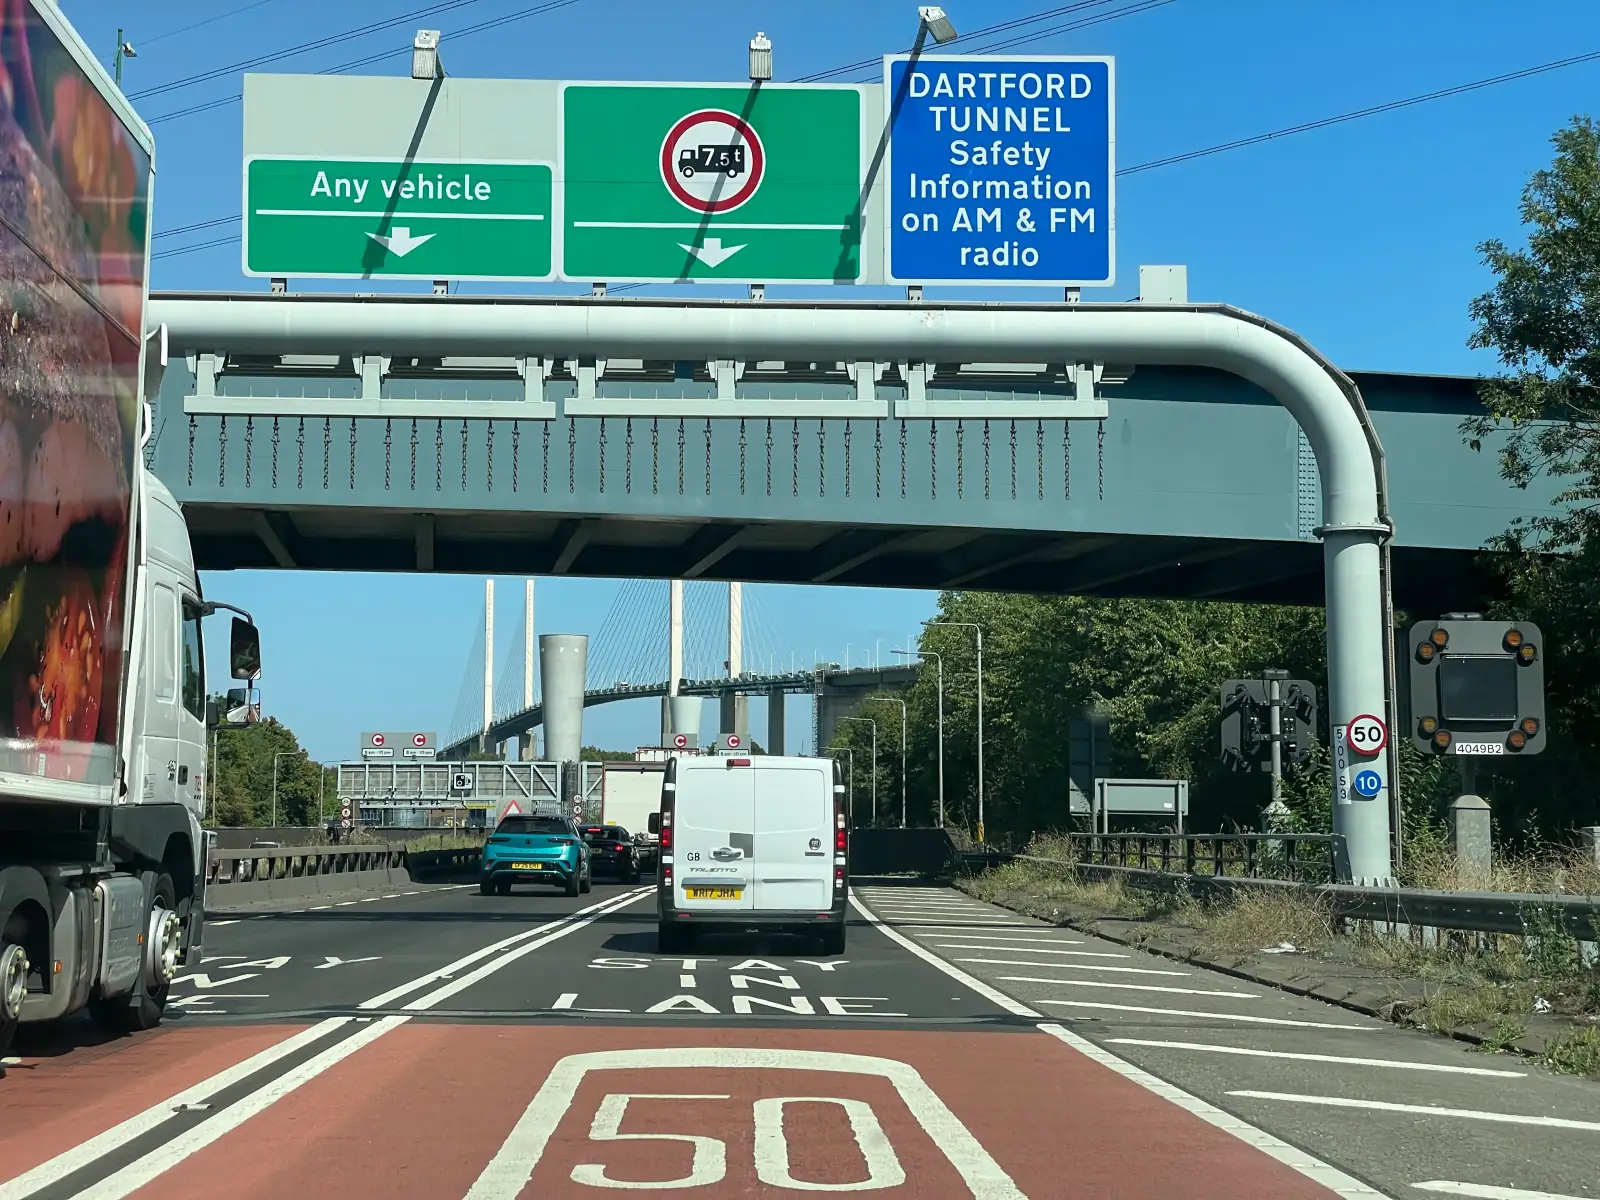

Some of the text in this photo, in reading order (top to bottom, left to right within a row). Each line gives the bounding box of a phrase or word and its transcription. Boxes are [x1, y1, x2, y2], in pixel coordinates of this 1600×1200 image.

[909, 72, 1092, 99] DARTFORD
[929, 106, 1071, 132] TUNNEL
[950, 139, 1051, 171] Safety
[310, 171, 491, 204] Any vehicle
[910, 173, 1091, 200] Information
[902, 207, 1095, 233] on AM & FM
[961, 241, 1039, 267] radio
[1353, 725, 1382, 743] 50
[1457, 744, 1502, 754] 4049B2
[1358, 776, 1378, 790] 10
[686, 852, 701, 862] GB
[692, 887, 736, 898] WR17 JHA
[587, 957, 850, 972] STAY
[679, 974, 801, 990] IN
[551, 993, 909, 1017] LANE
[569, 1093, 907, 1192] 50
